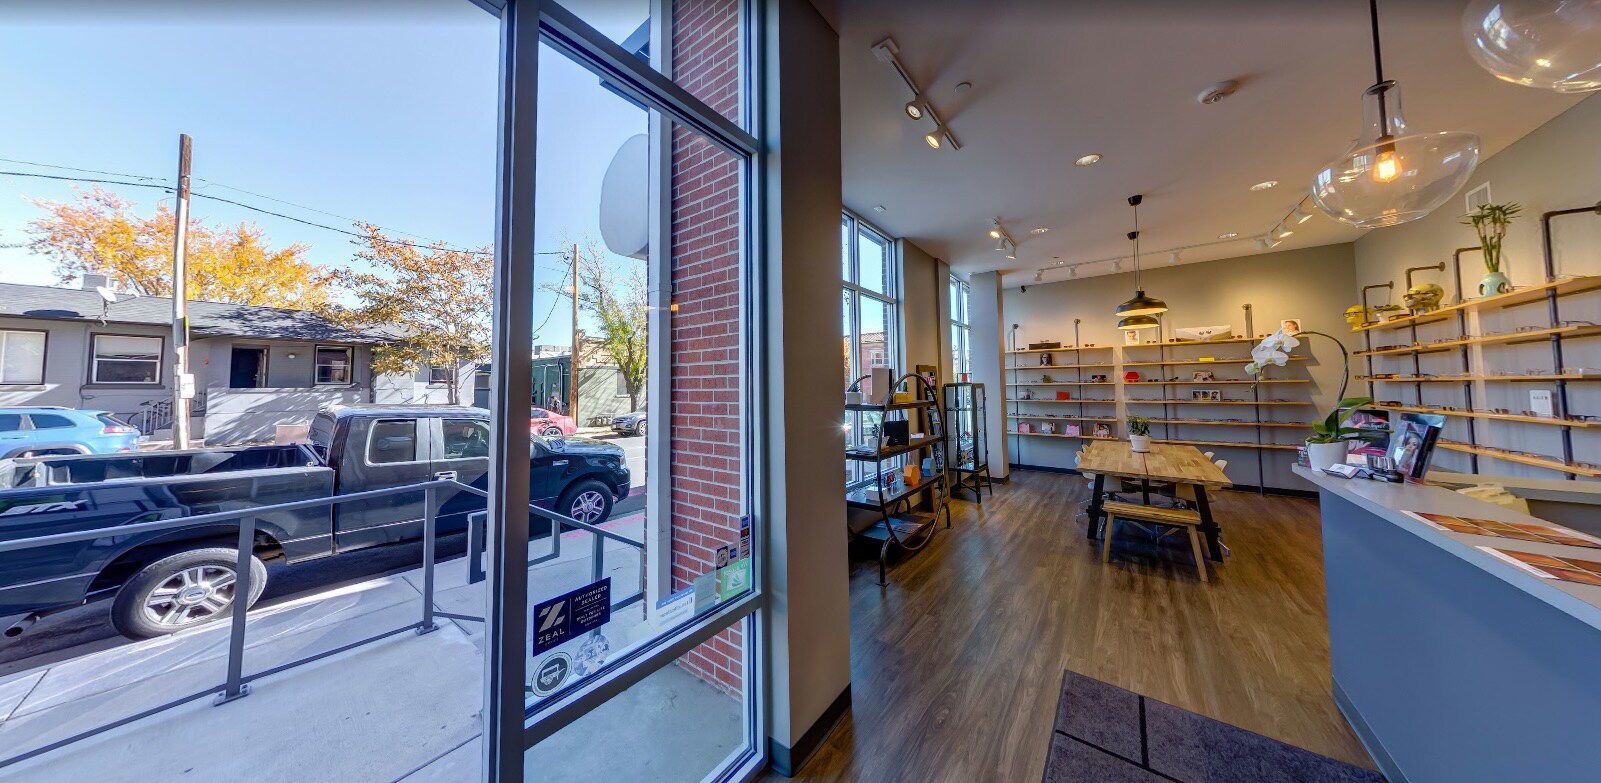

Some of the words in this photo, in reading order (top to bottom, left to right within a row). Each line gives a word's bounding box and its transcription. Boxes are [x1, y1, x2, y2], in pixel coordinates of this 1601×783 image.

[574, 585, 608, 602] AUTHORIZED
[581, 593, 602, 606] DEALER
[538, 628, 565, 645] ZEAL
